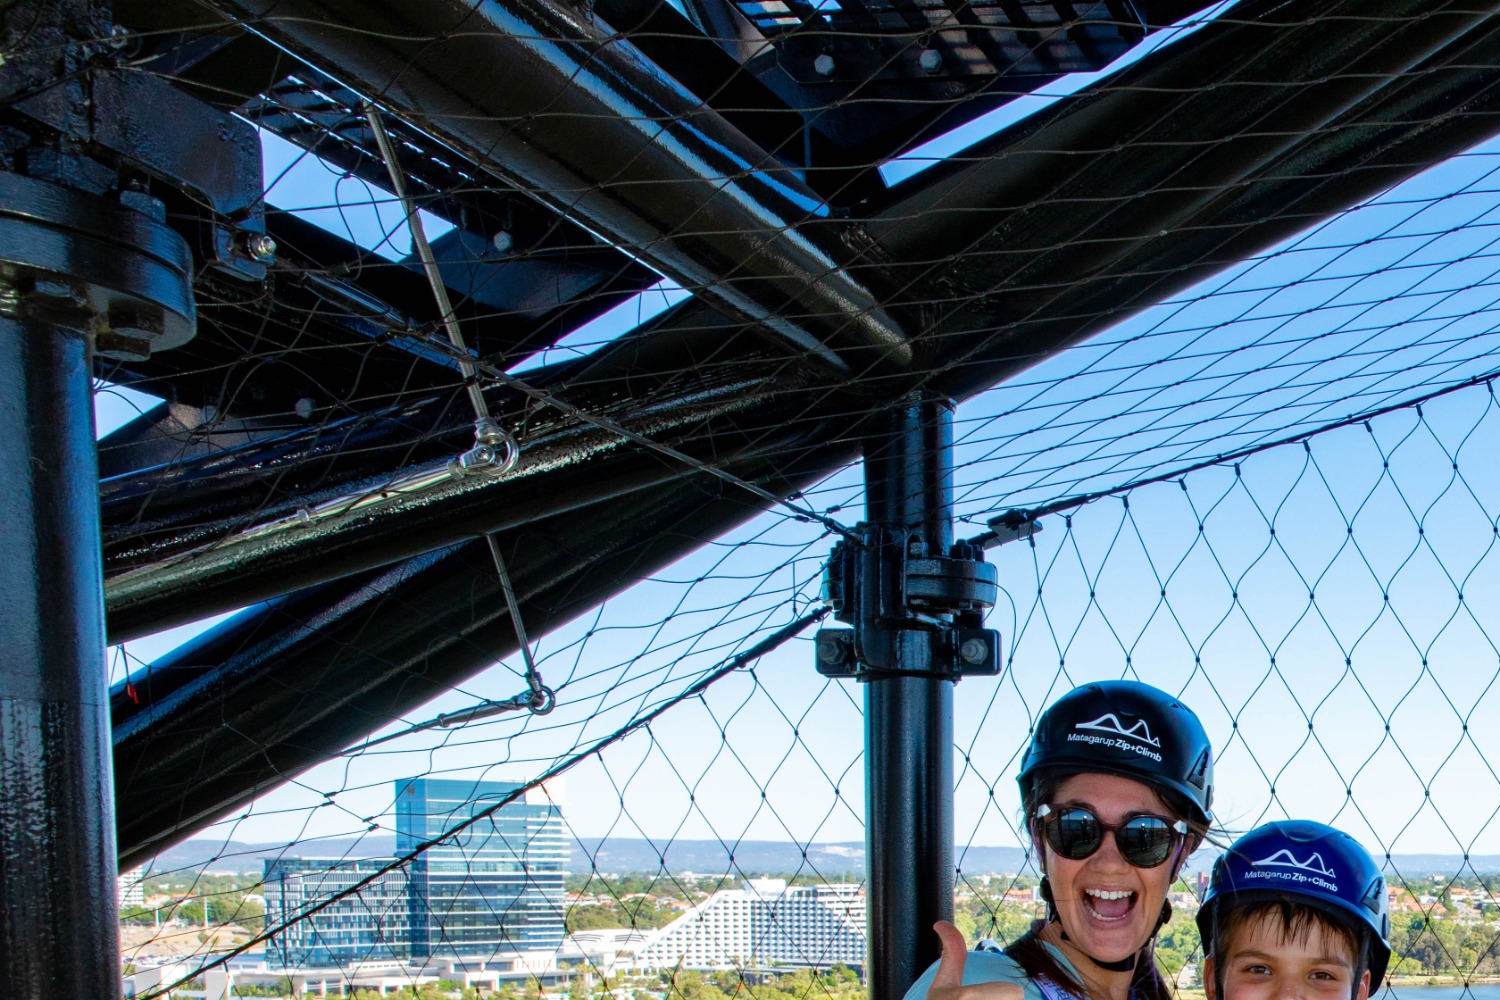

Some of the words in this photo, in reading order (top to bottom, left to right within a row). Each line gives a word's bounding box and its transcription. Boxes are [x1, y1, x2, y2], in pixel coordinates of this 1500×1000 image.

[1067, 733, 1115, 746] Matagarup
[1115, 738, 1162, 762] Zip+Climb
[1245, 870, 1291, 880] Matagarup
[1292, 872, 1338, 892] Zip+Climb
